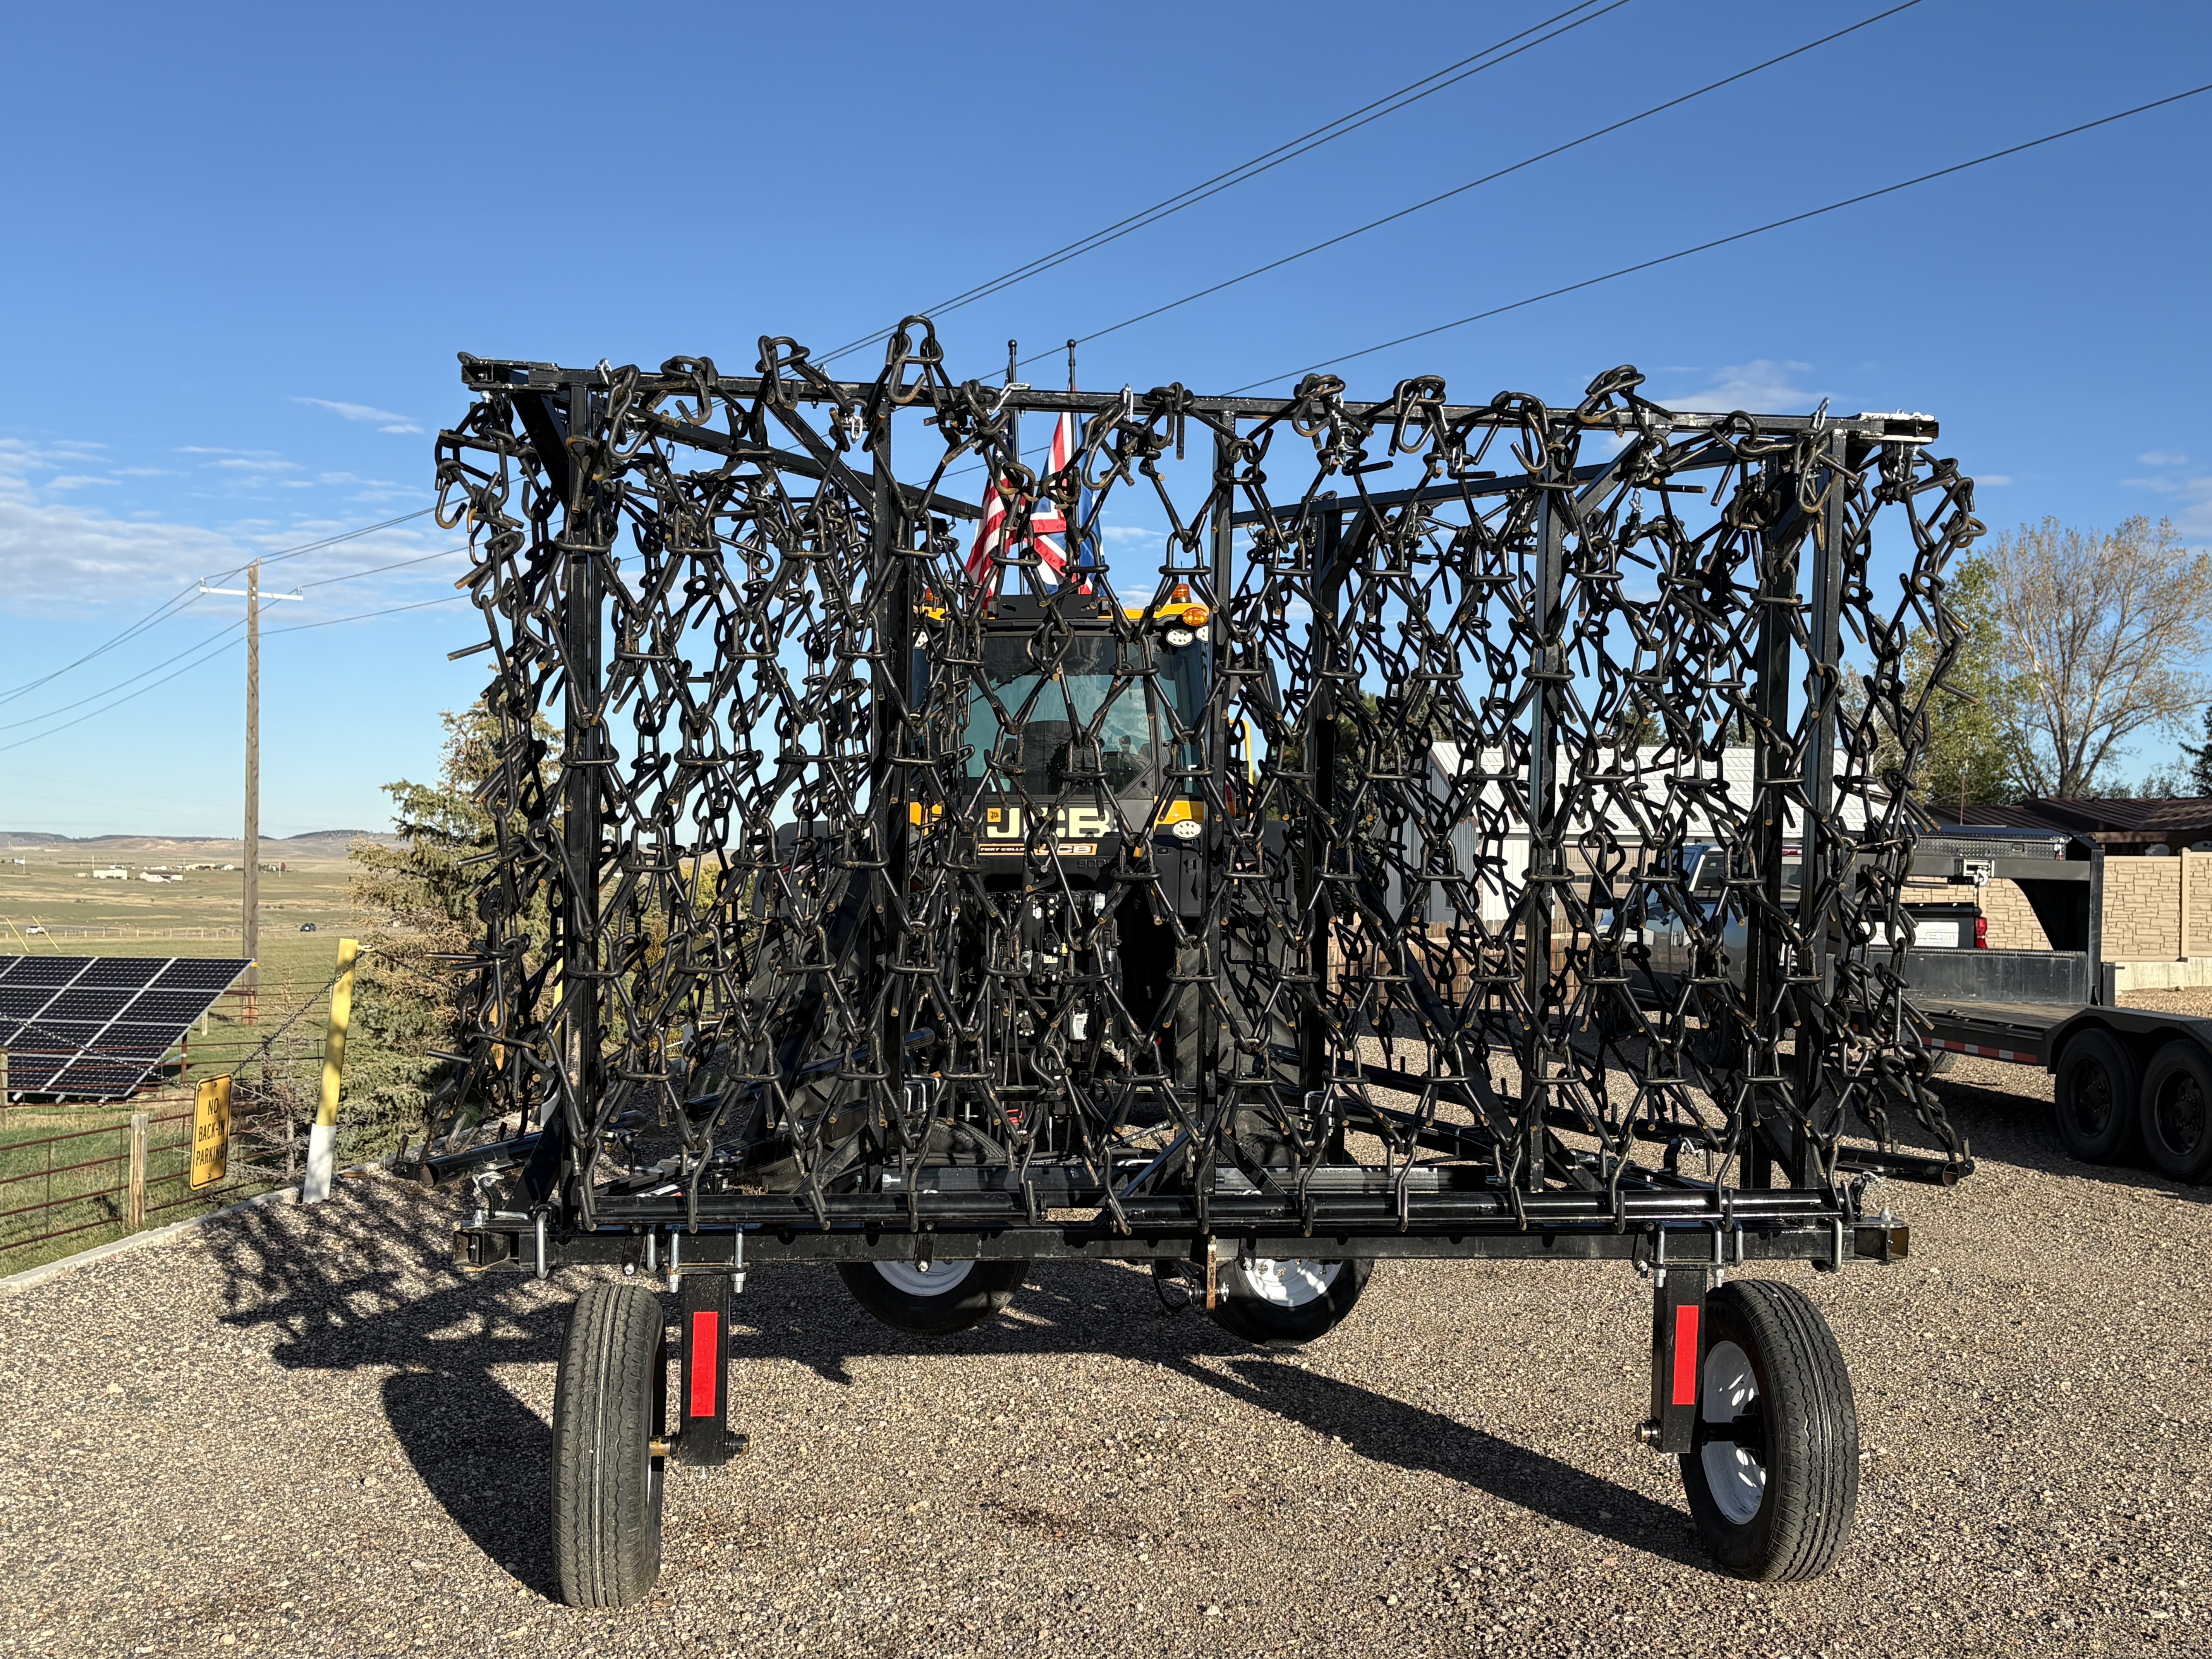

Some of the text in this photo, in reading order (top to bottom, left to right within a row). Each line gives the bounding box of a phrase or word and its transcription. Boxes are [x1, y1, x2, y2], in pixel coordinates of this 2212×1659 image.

[208, 1097, 219, 1115] NO
[198, 1120, 225, 1142] BACK-IN
[196, 1143, 224, 1167] PARKING
